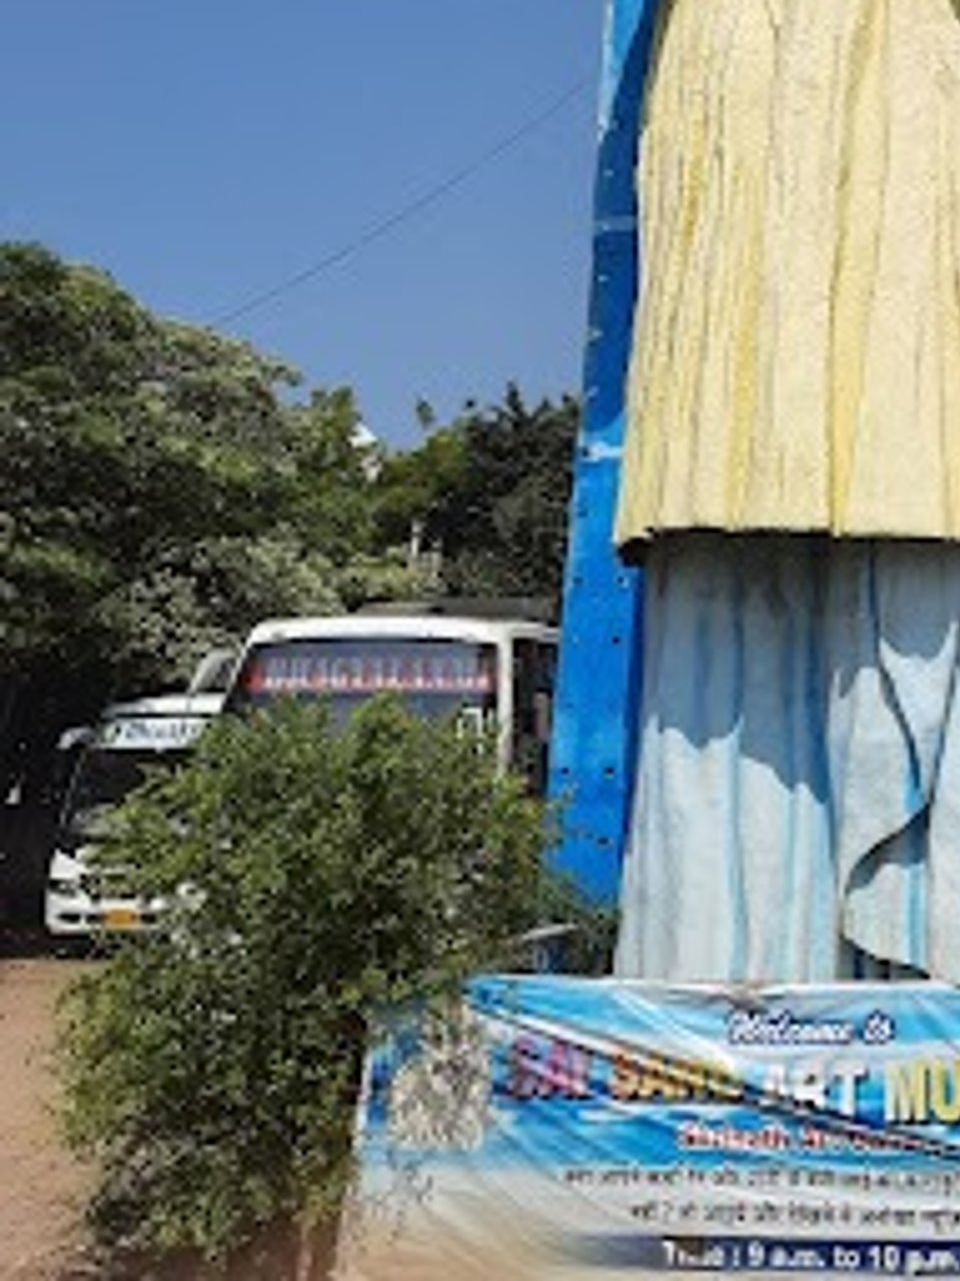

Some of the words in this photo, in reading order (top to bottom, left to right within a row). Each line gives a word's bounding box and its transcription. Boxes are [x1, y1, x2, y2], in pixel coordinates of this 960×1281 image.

[748, 1241, 764, 1267] 9
[833, 1245, 860, 1267] to
[868, 1245, 898, 1268] 10
